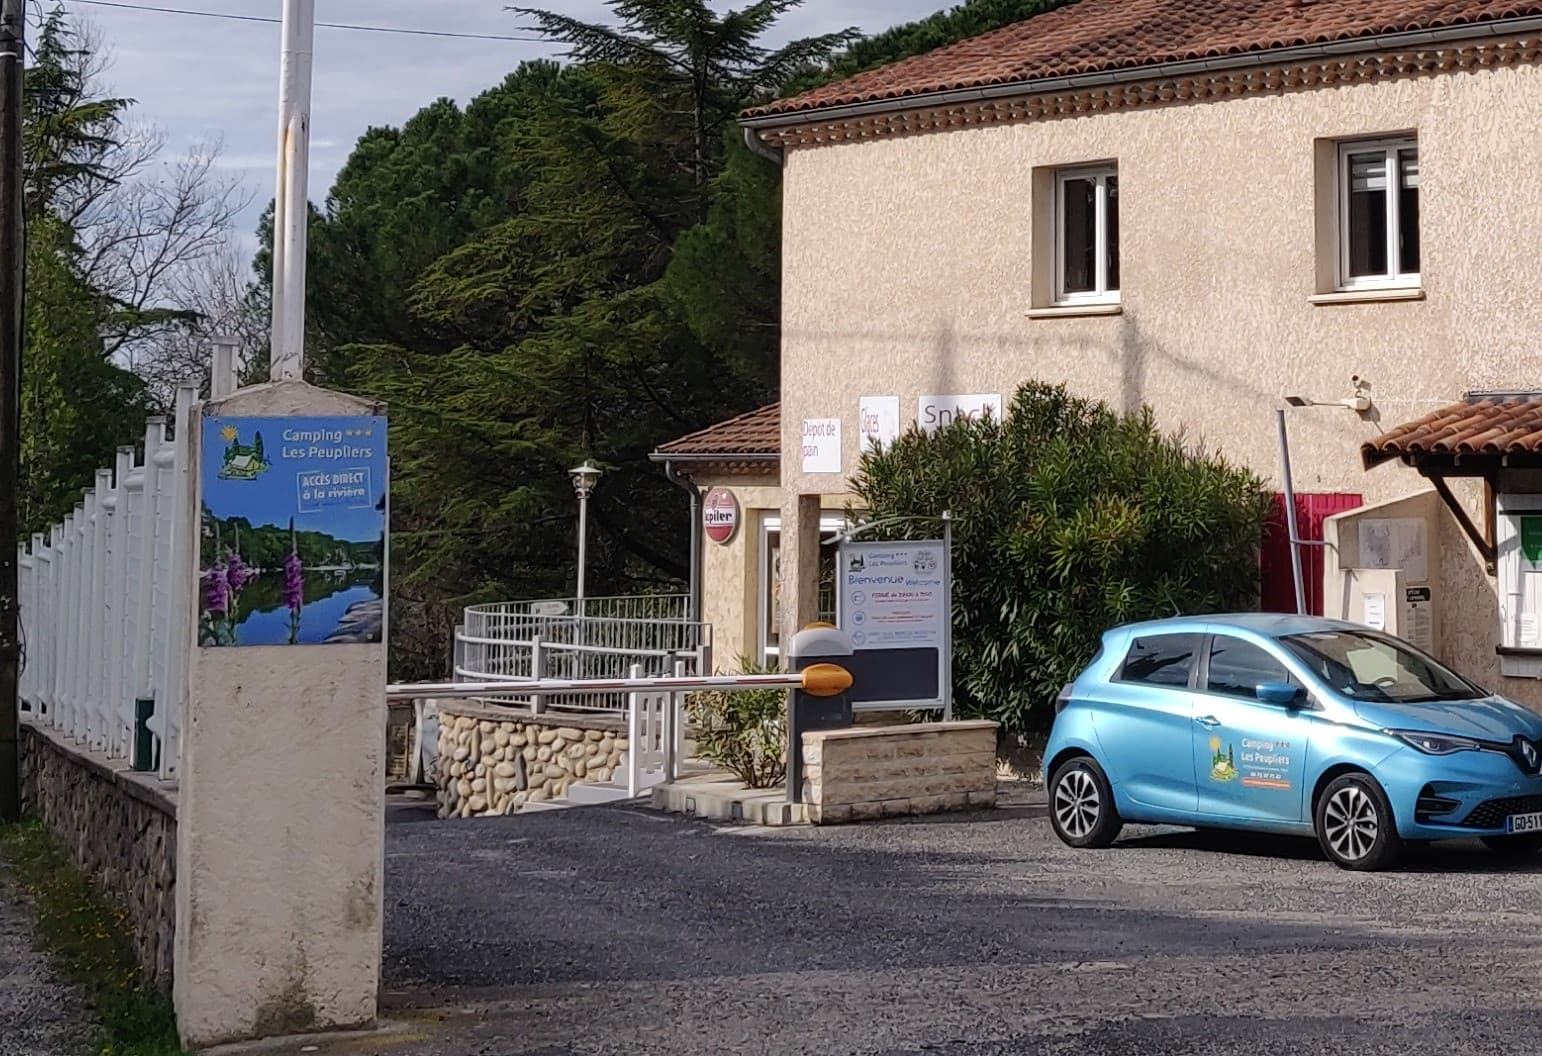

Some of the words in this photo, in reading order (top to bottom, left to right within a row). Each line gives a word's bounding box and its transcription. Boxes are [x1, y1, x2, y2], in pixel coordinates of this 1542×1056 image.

[282, 428, 342, 443] Camping
[826, 421, 836, 436] de
[282, 446, 306, 458] Les
[309, 444, 373, 460] Peupliers
[303, 473, 331, 487] ACCÈS
[332, 471, 365, 485] DIRECT
[314, 488, 326, 500] la
[328, 486, 366, 498] rivière
[704, 509, 732, 524] upiler
[848, 574, 904, 585] Bienvenue
